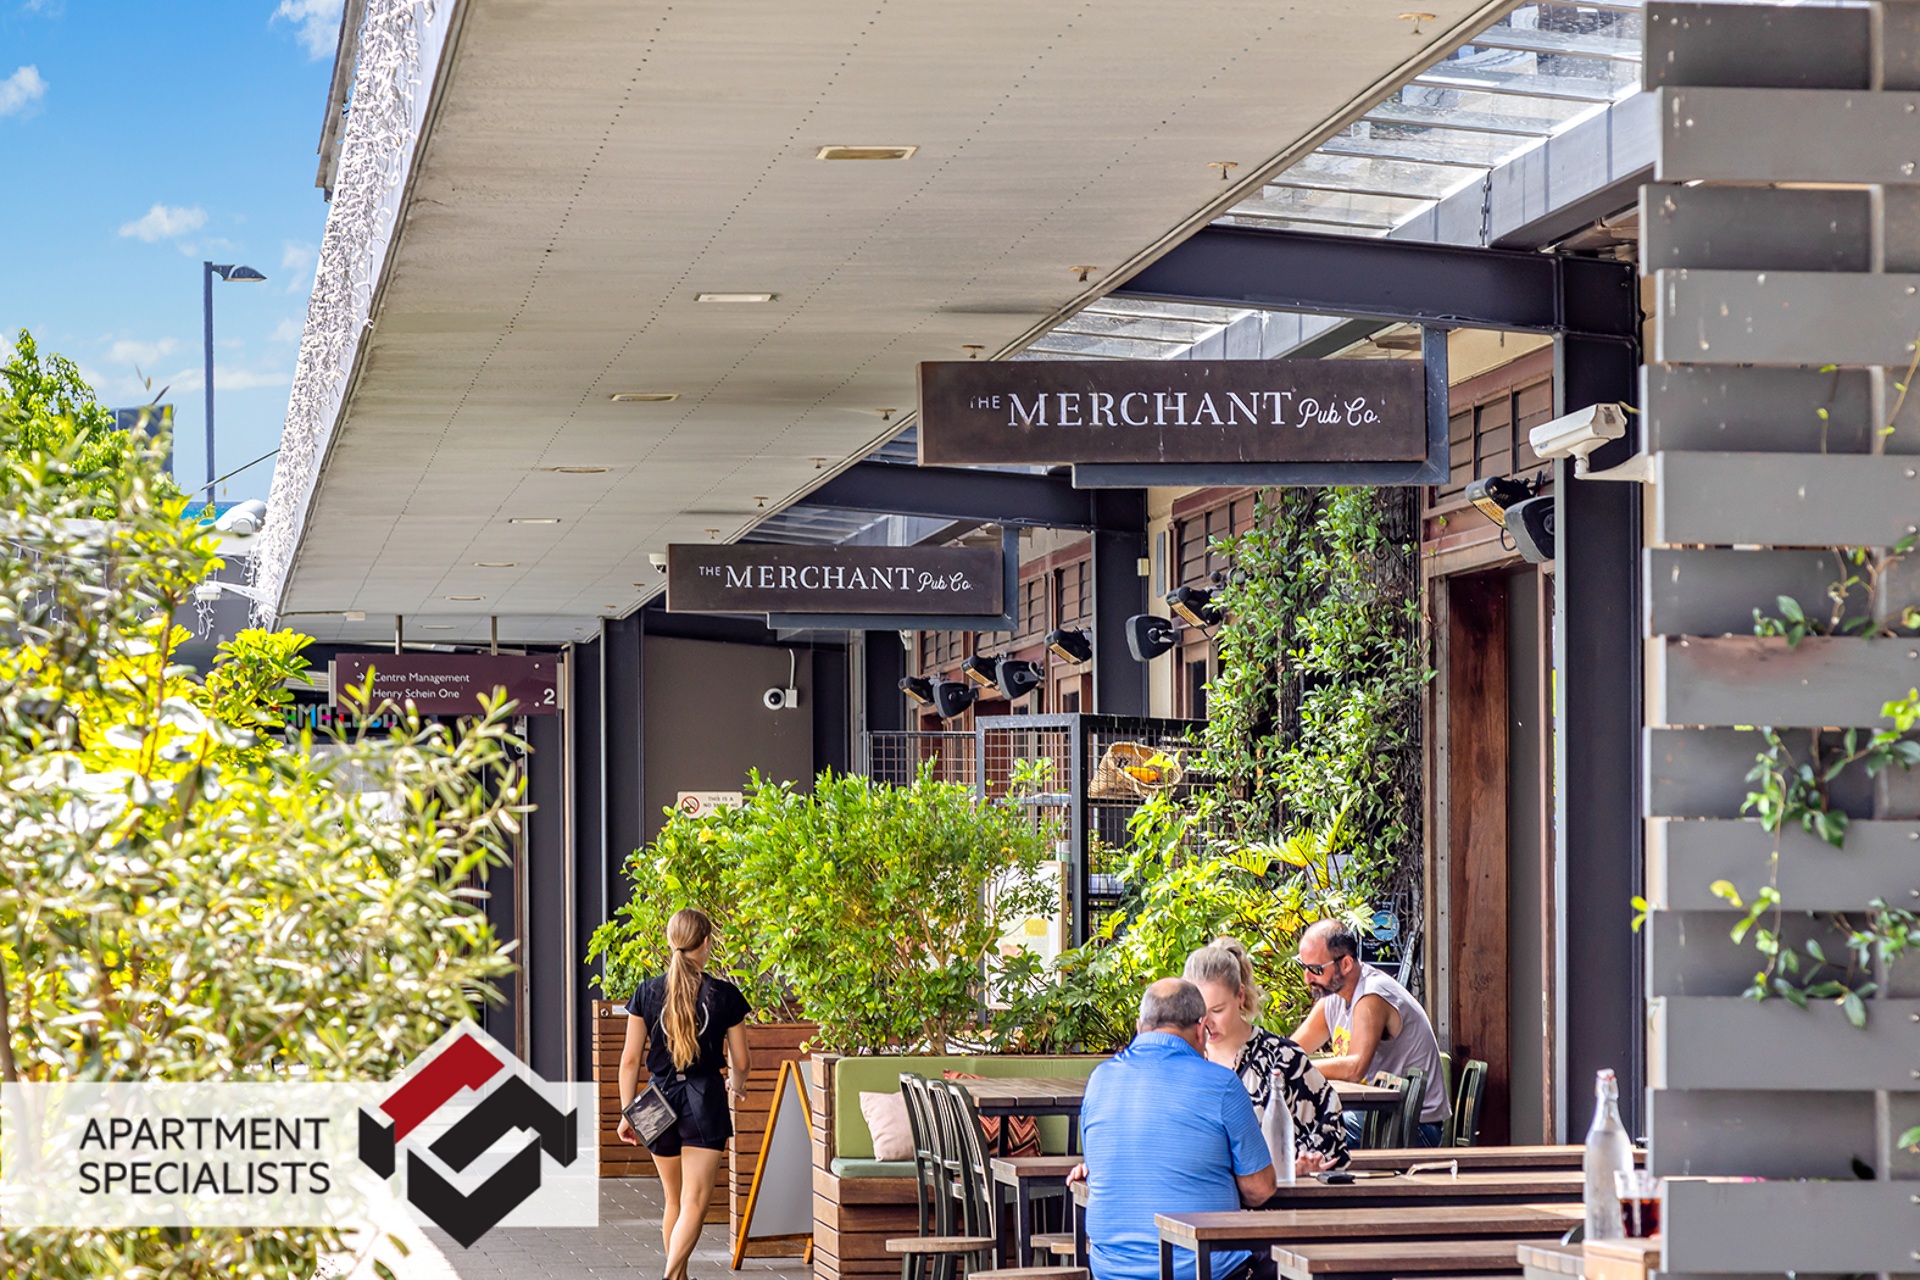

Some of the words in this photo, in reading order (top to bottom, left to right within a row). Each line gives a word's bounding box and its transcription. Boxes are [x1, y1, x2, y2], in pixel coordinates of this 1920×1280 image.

[969, 395, 1001, 409] THE
[1007, 391, 1292, 427] MERCHANT
[1296, 397, 1342, 428] Pub
[699, 566, 721, 576] THE
[725, 565, 915, 591] MERCHANT
[917, 571, 947, 592] Pub
[373, 672, 407, 682] Centre
[409, 672, 470, 685] Management
[372, 688, 403, 700] Henry
[405, 688, 436, 698] Schein
[438, 688, 460, 698] One
[543, 688, 556, 704] 2
